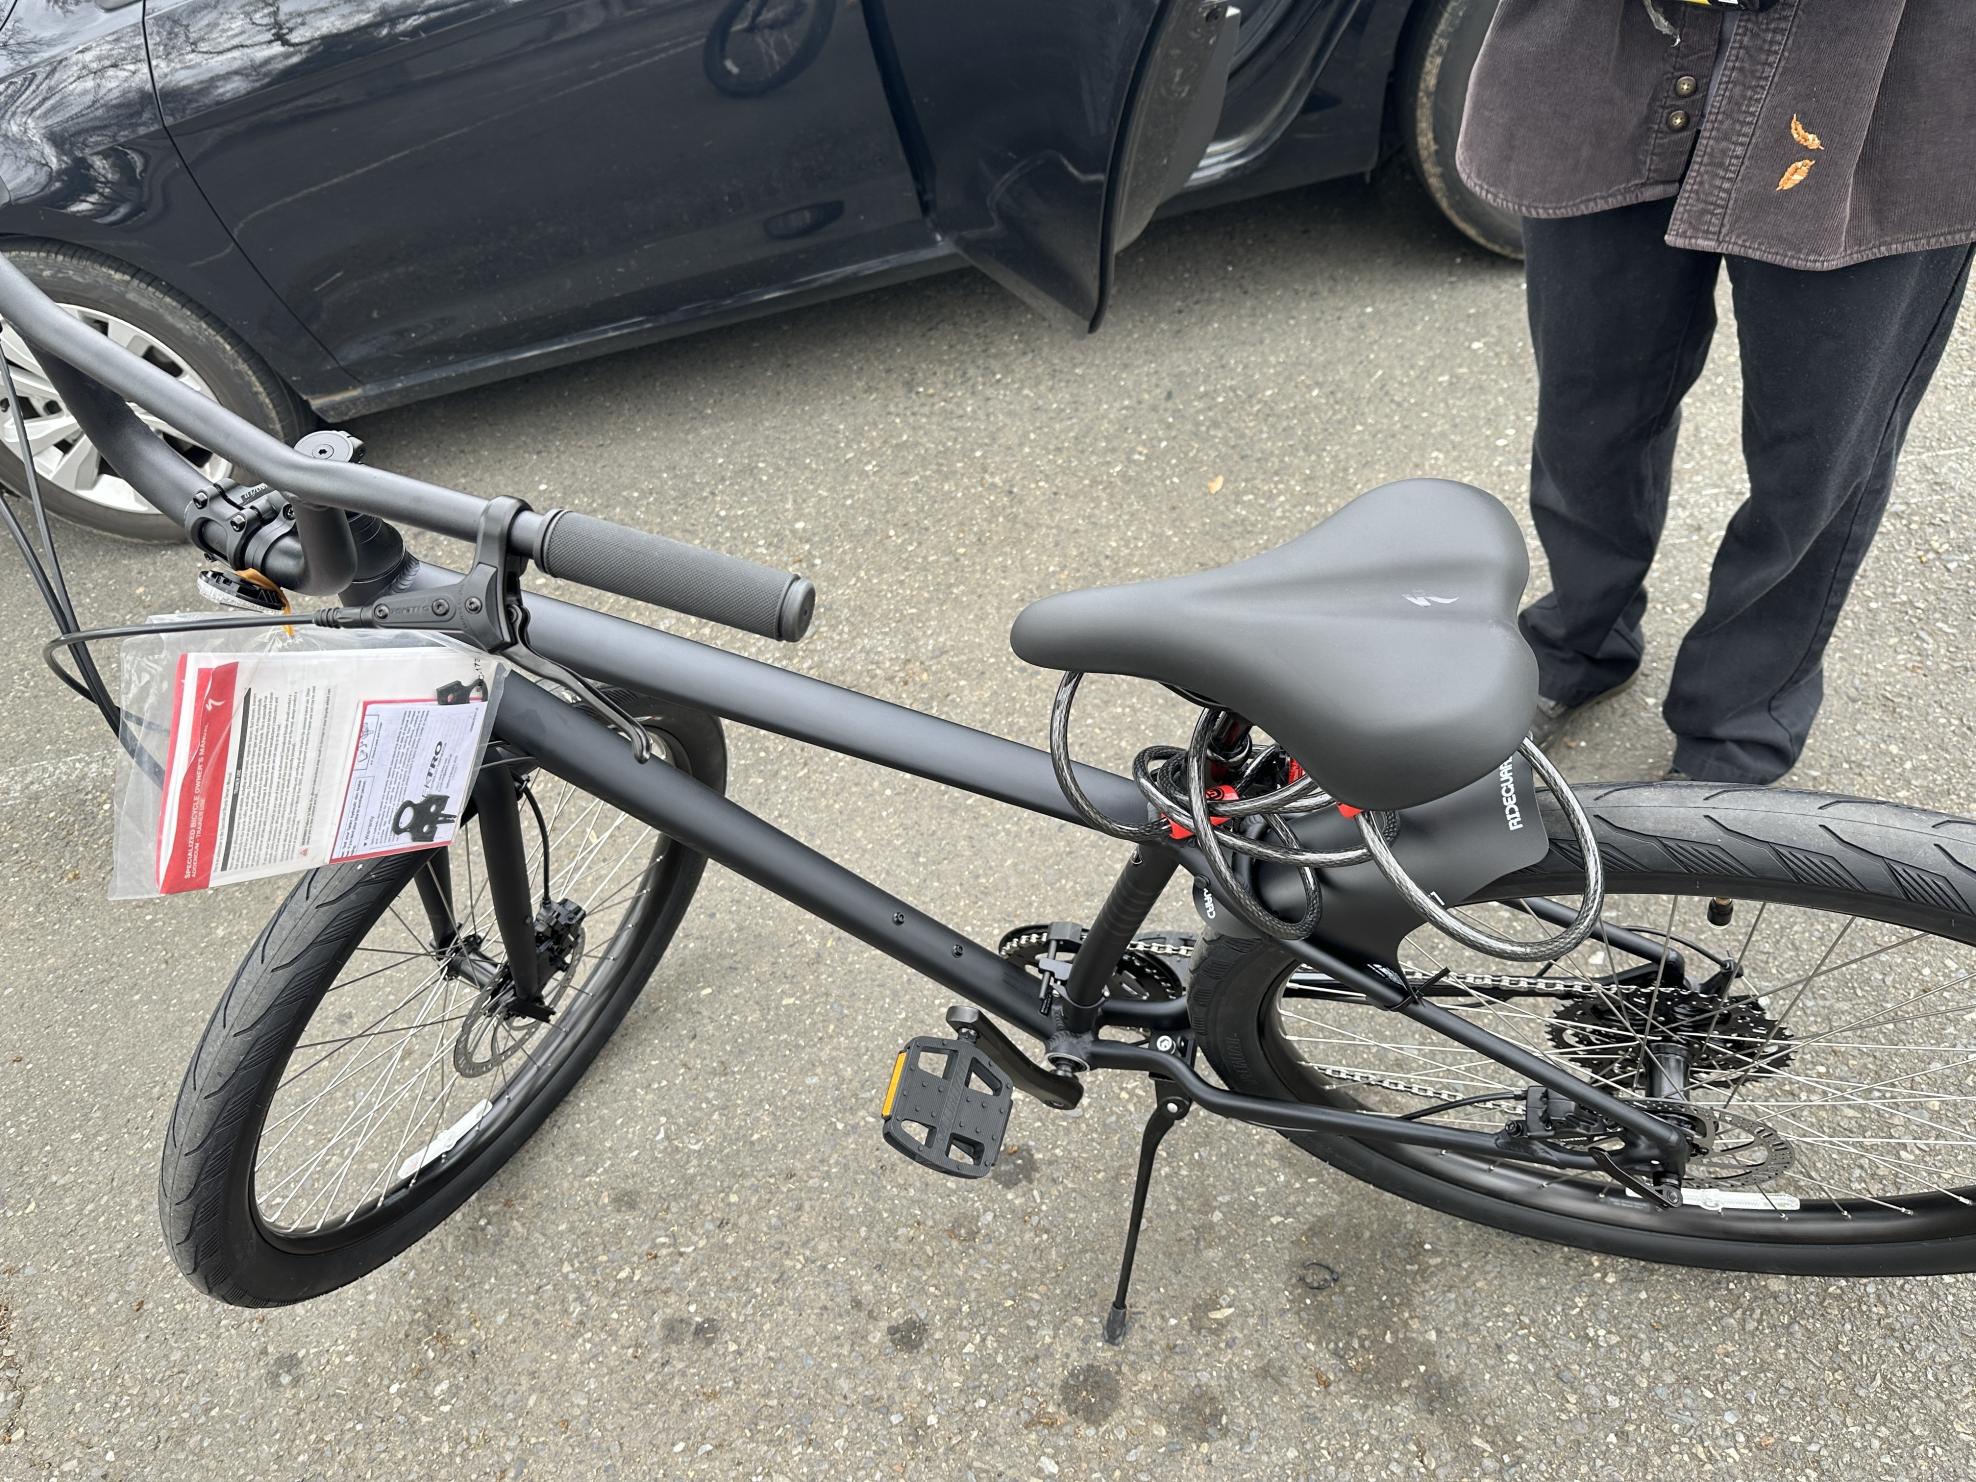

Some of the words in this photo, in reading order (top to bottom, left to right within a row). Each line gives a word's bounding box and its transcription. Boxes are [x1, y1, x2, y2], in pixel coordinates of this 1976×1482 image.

[199, 724, 209, 755] MANUAL
[194, 756, 204, 792] OWNER'S
[190, 794, 199, 825] BICYCLE
[1500, 756, 1523, 831] RIDEGUAR
[195, 812, 204, 838] TRAINER
[184, 827, 195, 879] SPECIALIZED
[191, 844, 200, 877] ADDENDUM
